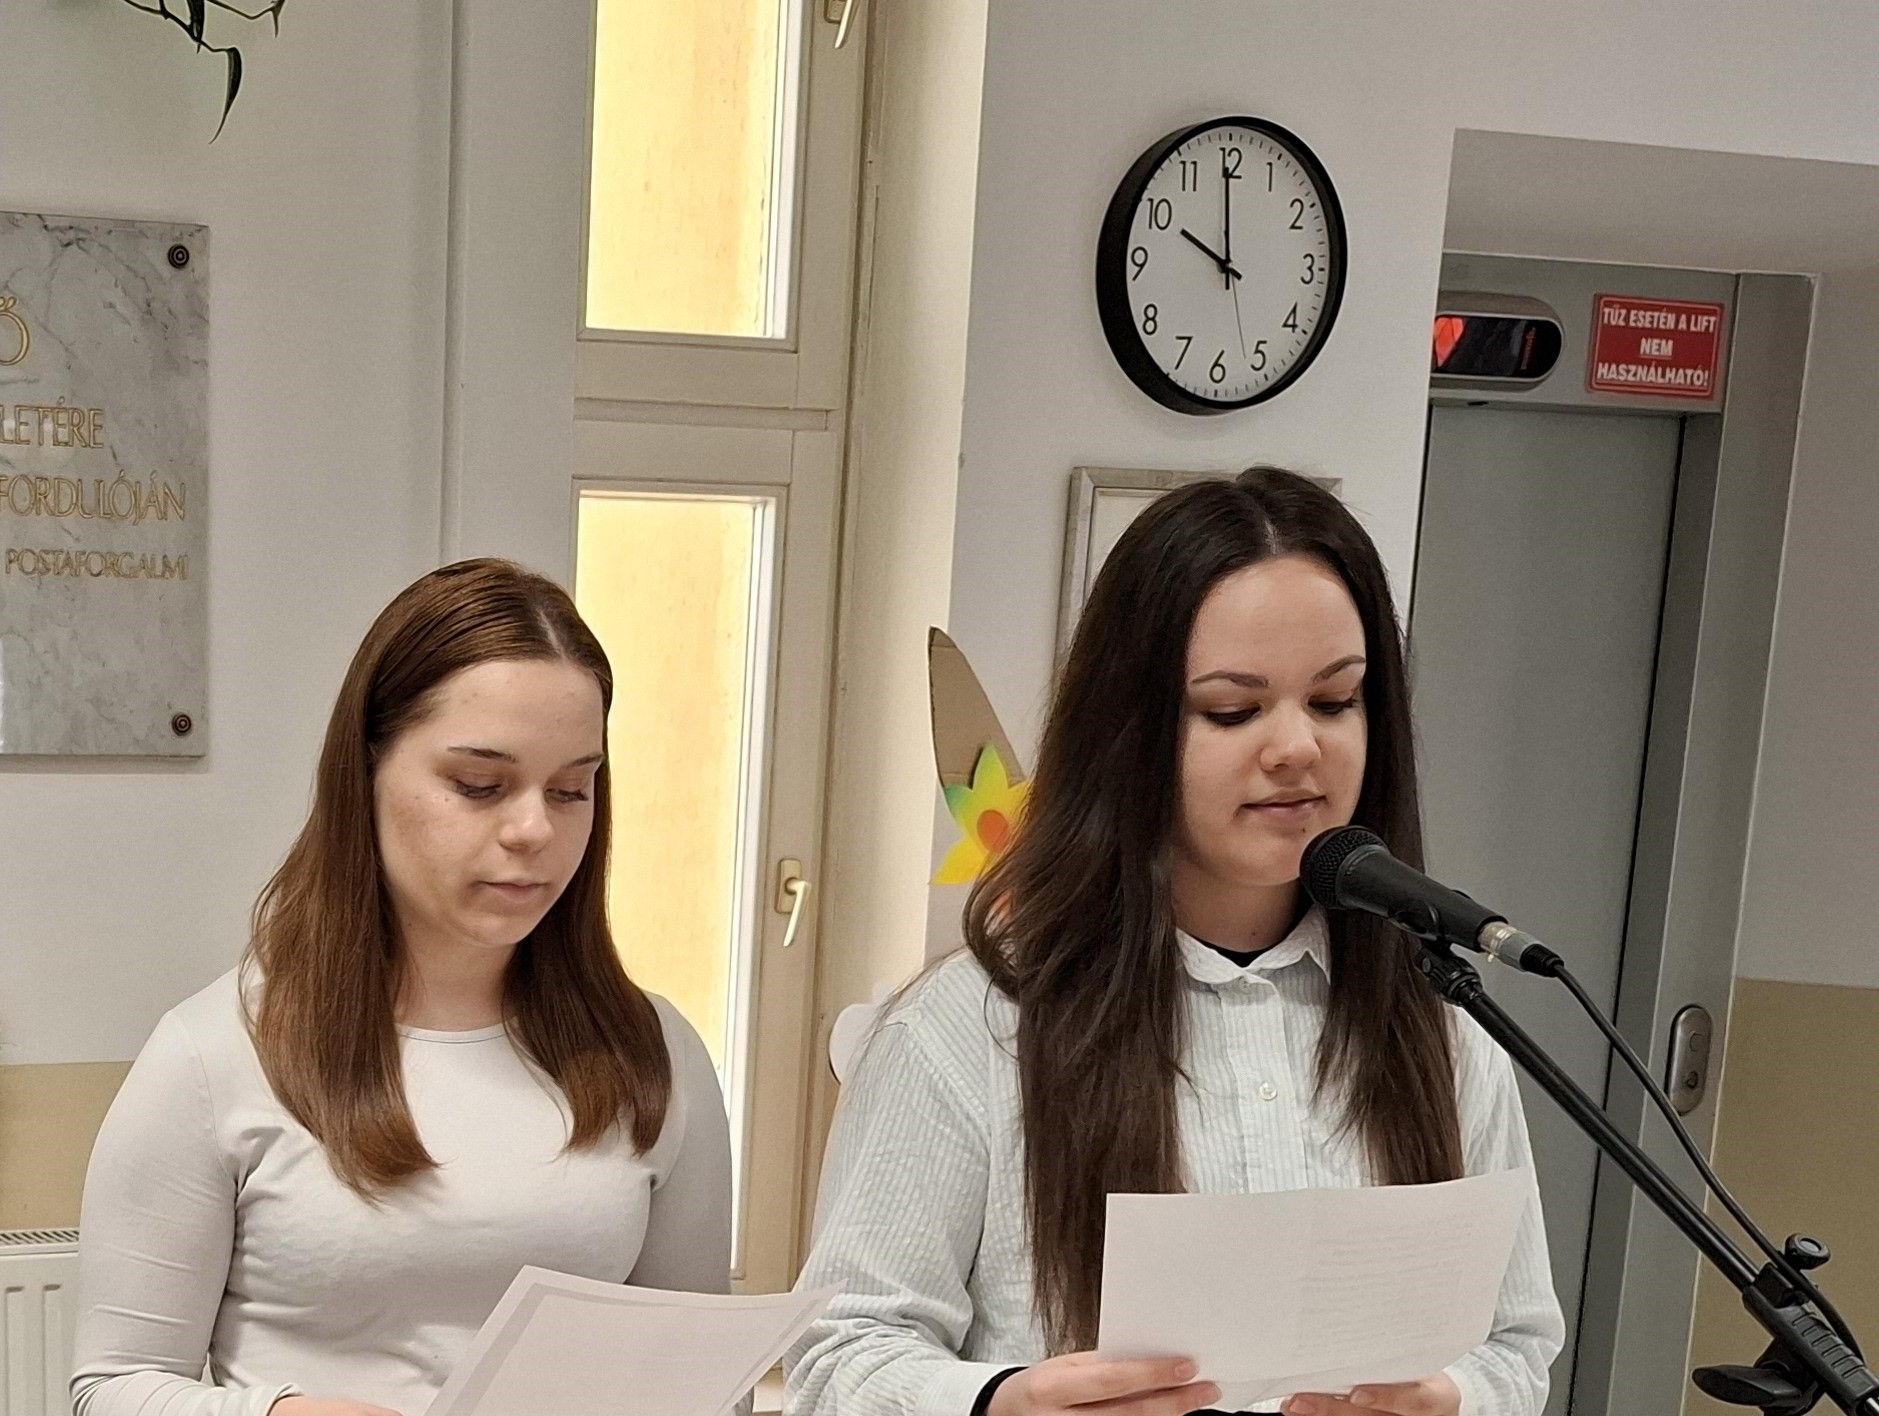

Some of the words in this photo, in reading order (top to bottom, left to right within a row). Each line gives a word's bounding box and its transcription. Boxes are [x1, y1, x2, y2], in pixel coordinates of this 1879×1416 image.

[1179, 160, 1198, 192] 11
[1219, 147, 1243, 179] 12
[1266, 161, 1273, 192] 1
[1147, 198, 1172, 230] 10
[1289, 198, 1304, 230] 2
[1131, 246, 1148, 281] 9
[1300, 253, 1315, 284] 3
[1142, 303, 1158, 335] 8
[1282, 302, 1299, 333] 4
[1602, 304, 1627, 326] TŰZ
[1629, 307, 1676, 329] ESETÉN
[1677, 313, 1688, 330] A
[1689, 314, 1717, 333] LIFT
[1175, 336, 1193, 370] 7
[1250, 340, 1267, 371] 5
[1640, 337, 1674, 356] NEM
[1209, 350, 1226, 383] 6
[1596, 360, 1709, 386] HASZNÁLHATÓ!
[5, 547, 190, 581] POSTAFORGALMI
